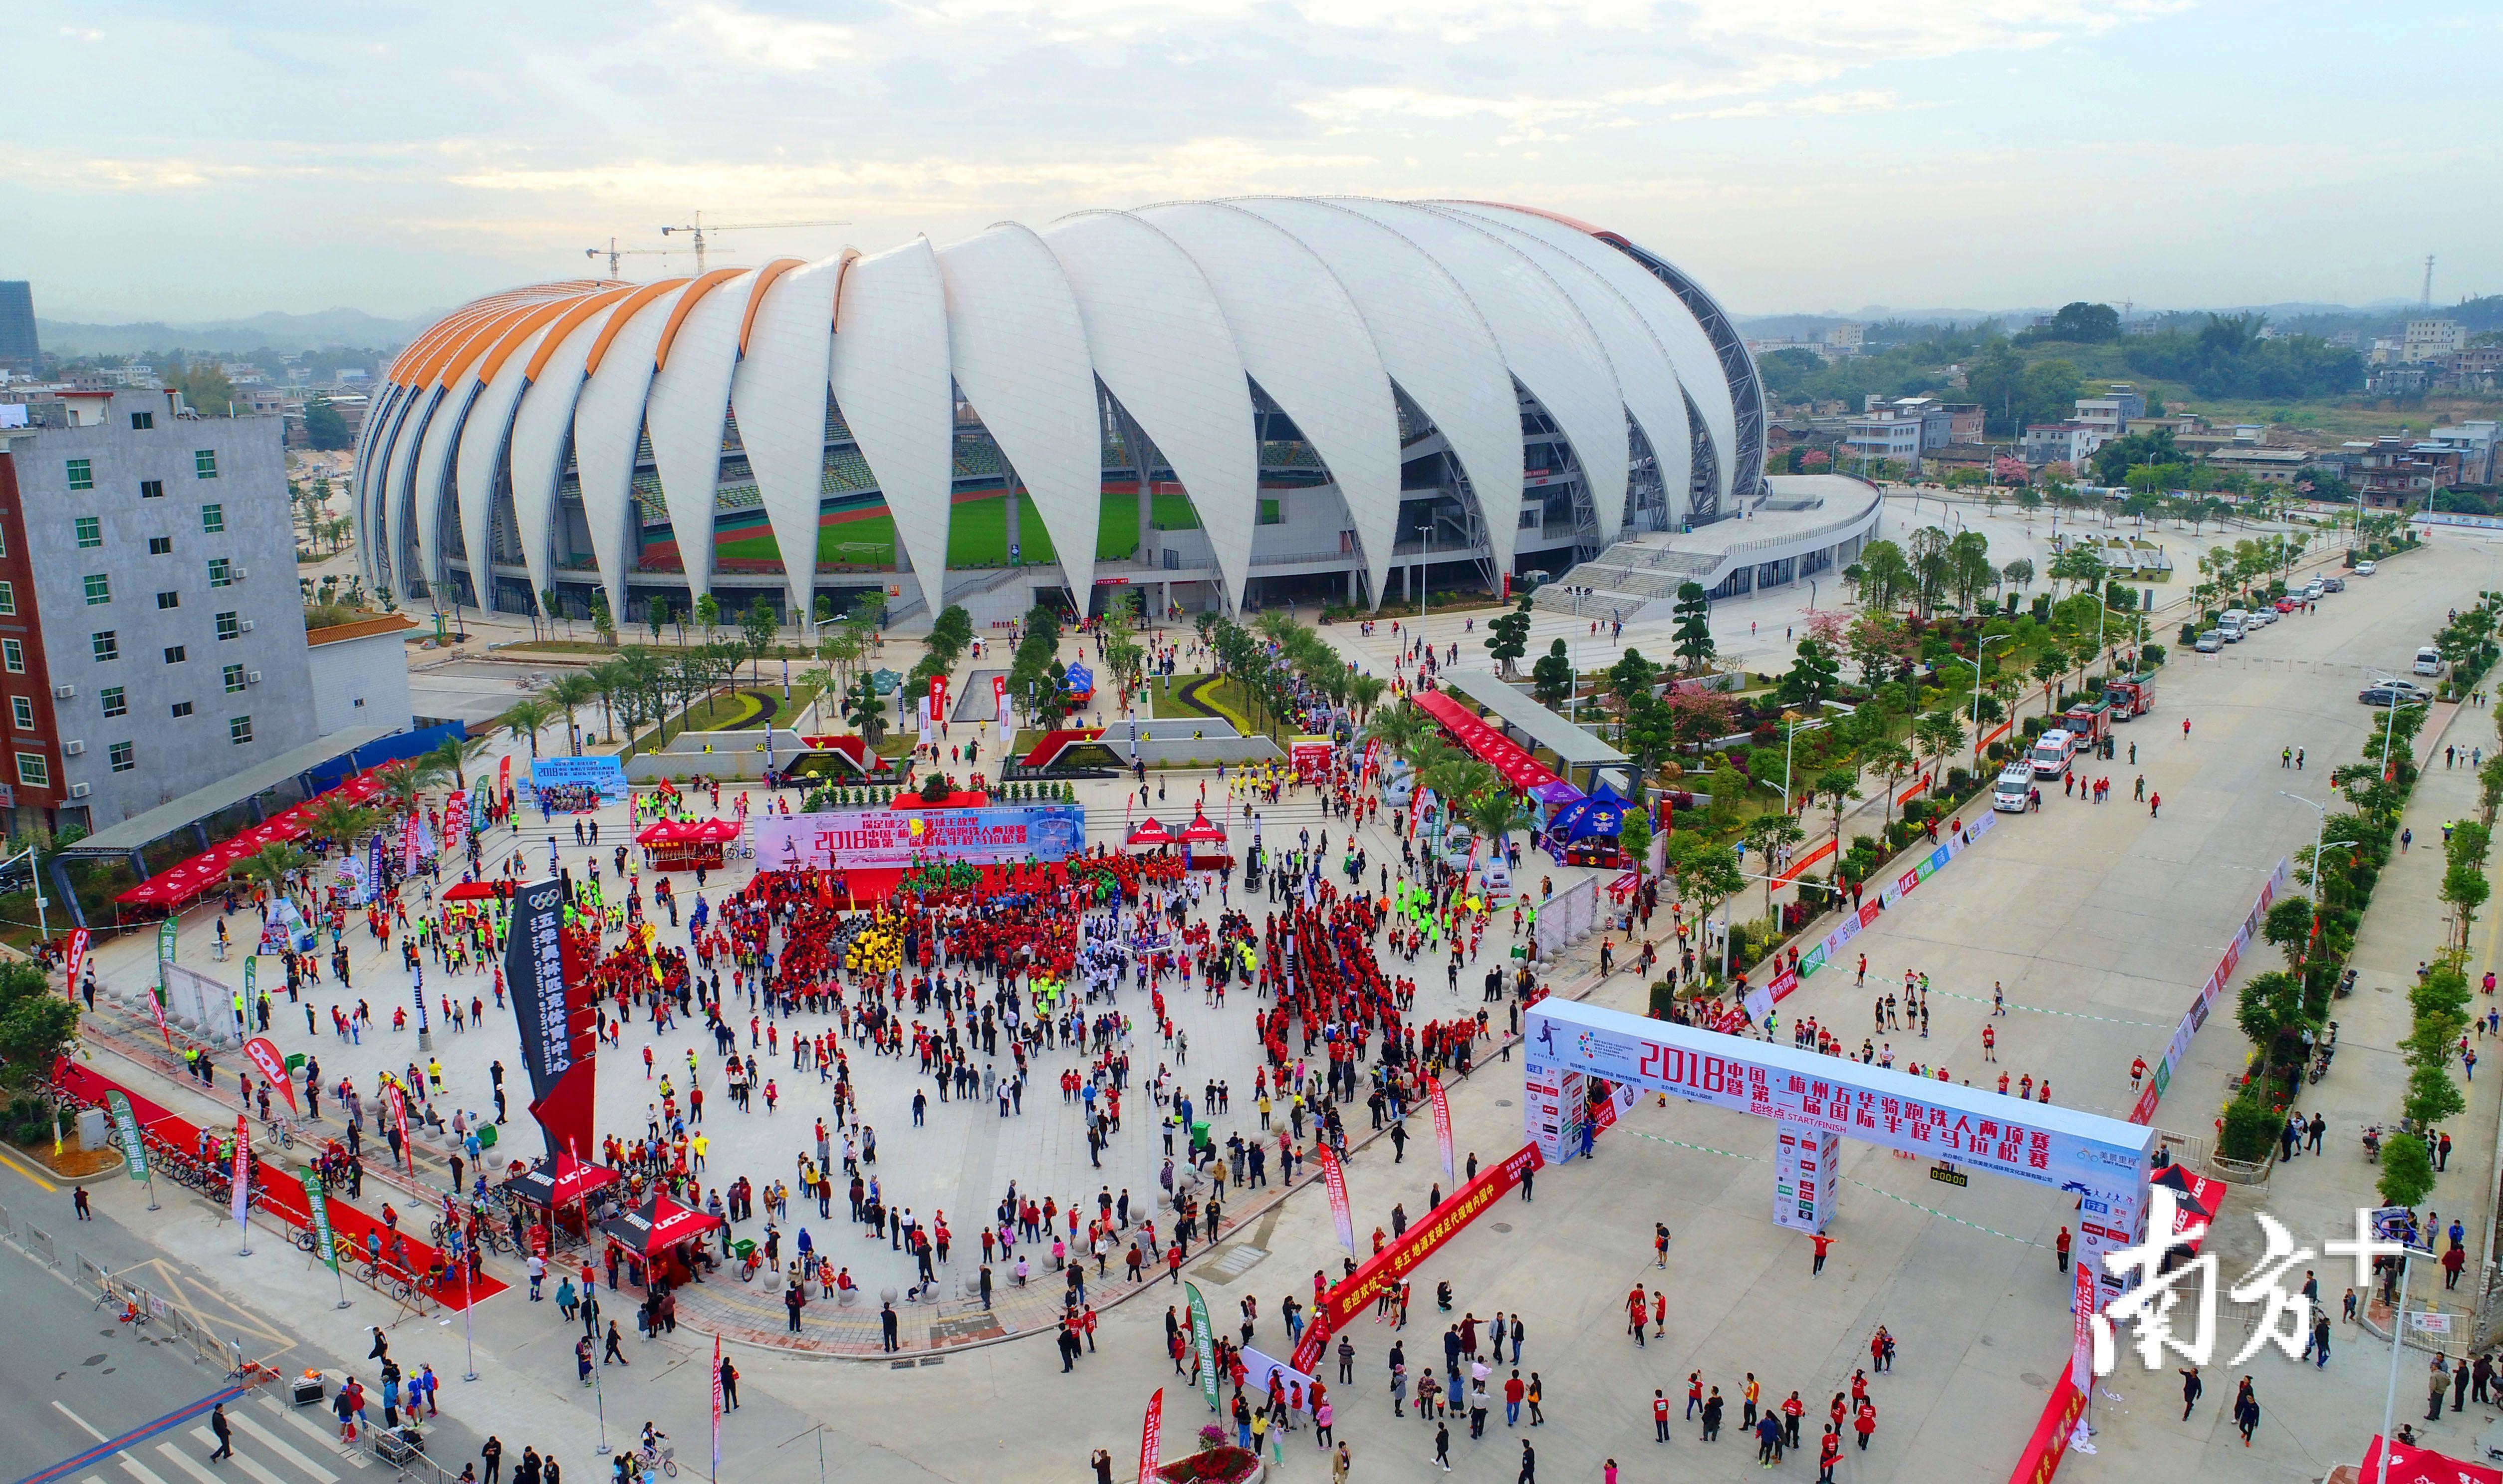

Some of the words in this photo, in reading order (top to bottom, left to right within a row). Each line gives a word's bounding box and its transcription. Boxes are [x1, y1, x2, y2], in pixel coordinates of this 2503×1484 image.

[1365, 738, 1380, 769] UCC
[538, 767, 558, 777] 2018
[1412, 786, 1427, 820] UCC
[445, 799, 462, 844] 京东体育
[814, 830, 868, 850] 2018
[1431, 815, 1443, 856] 美景里程
[1466, 837, 1480, 877] UCC
[370, 848, 380, 895] SAMSUNG
[1900, 871, 1918, 892] UCC
[529, 917, 538, 933] WU
[531, 936, 540, 957] HUA
[537, 911, 571, 1073] 五华奥林匹克体育中心
[1770, 971, 1796, 998] 京东体育
[1528, 1065, 1540, 1074] 行者
[1640, 1041, 1725, 1093] 2018
[1750, 1102, 1785, 1120] 起终点
[1727, 1078, 2049, 1171] 暨第二届国际半程马拉松赛
[1788, 1113, 1847, 1134] START/FINISH
[2099, 1150, 2137, 1167] 美景里程
[2116, 1162, 2133, 1171] Racing
[1931, 1170, 1966, 1186] 0:00:00
[2191, 1177, 2206, 1199] UCC
[567, 1180, 608, 1202] UCCIKE.COM
[2087, 1201, 2106, 1213] 行者
[655, 1211, 692, 1230] UCC
[2083, 1225, 2103, 1234] 京东体育
[2174, 1209, 2189, 1232] UCC
[662, 1227, 706, 1249] UCCBIKE.COM
[1144, 1414, 1155, 1450] 2018
